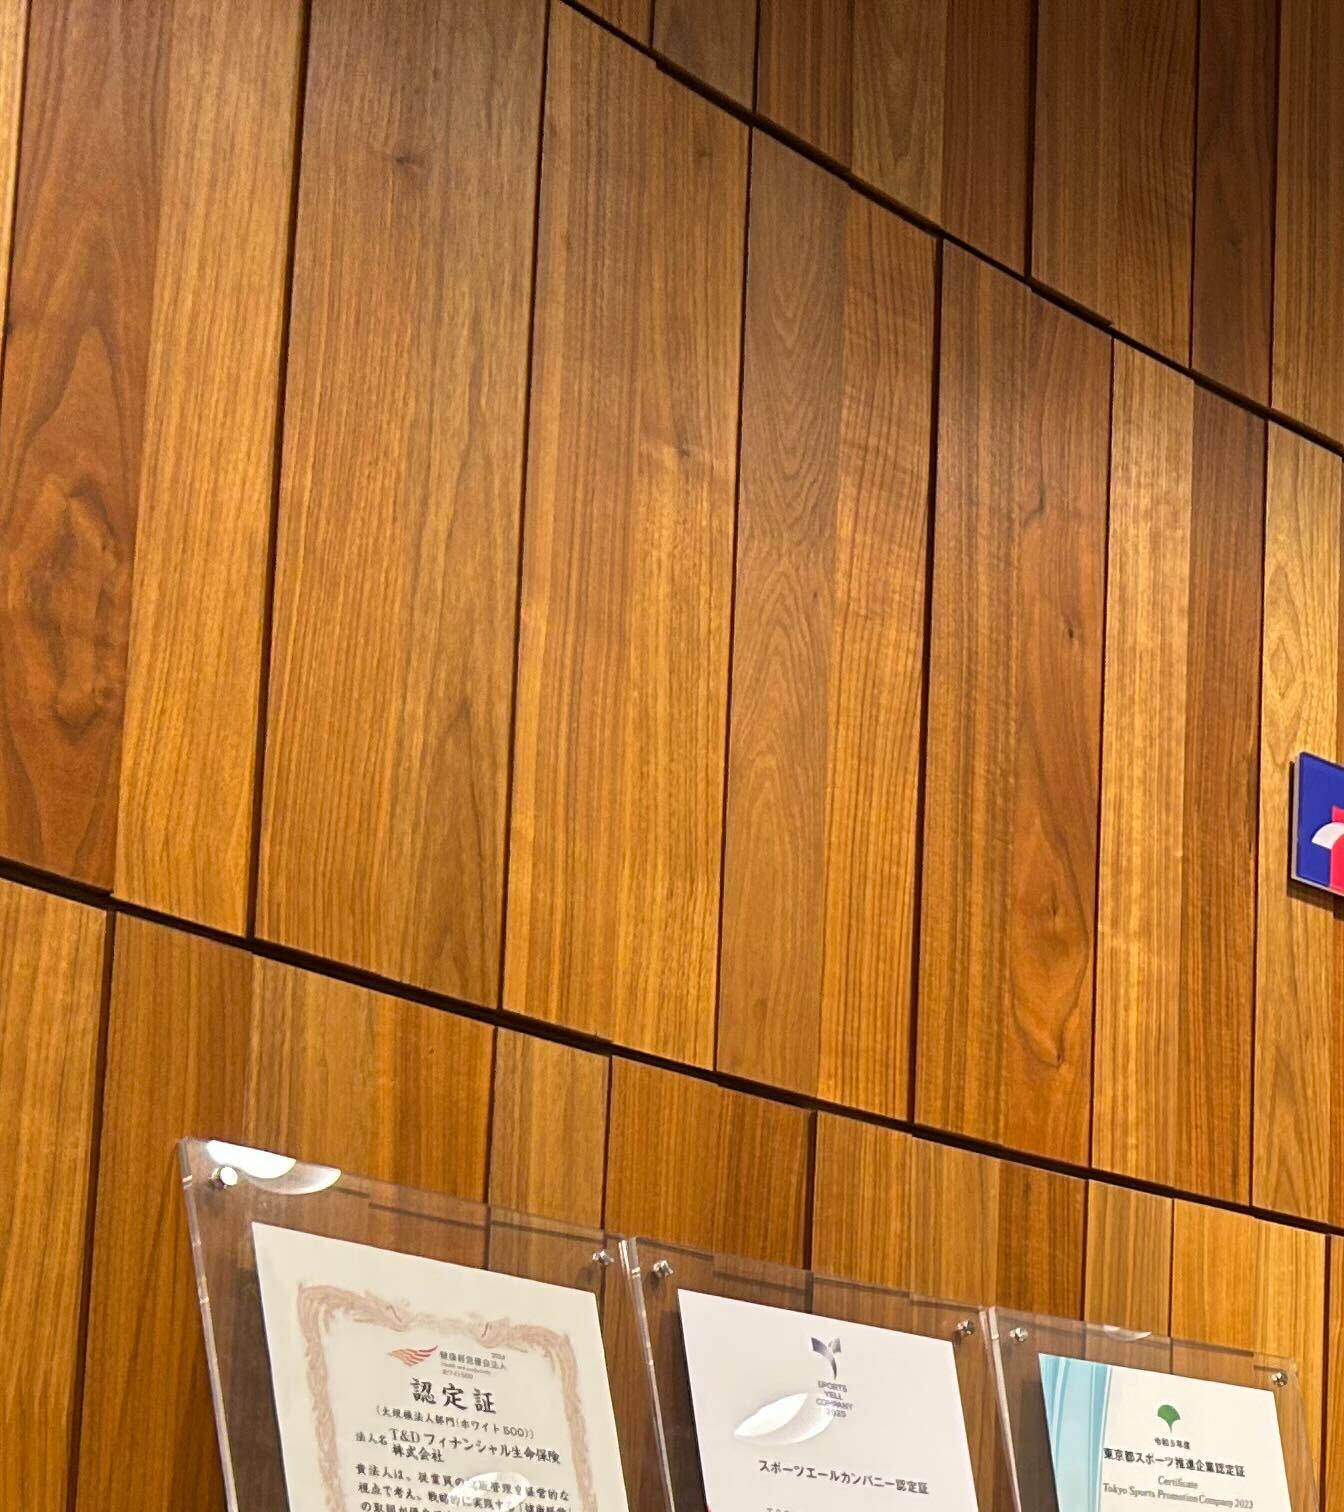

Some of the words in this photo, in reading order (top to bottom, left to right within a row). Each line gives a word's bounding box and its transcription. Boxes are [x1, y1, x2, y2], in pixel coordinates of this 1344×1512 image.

[410, 1378, 497, 1415] 認定証
[392, 1444, 445, 1463] 株式会社
[1103, 1447, 1246, 1477] 東京都スポーツ推進企業認定証
[758, 1460, 929, 1495] スポーツエールカンパニー認定証
[1103, 1482, 1128, 1495] Tokyo
